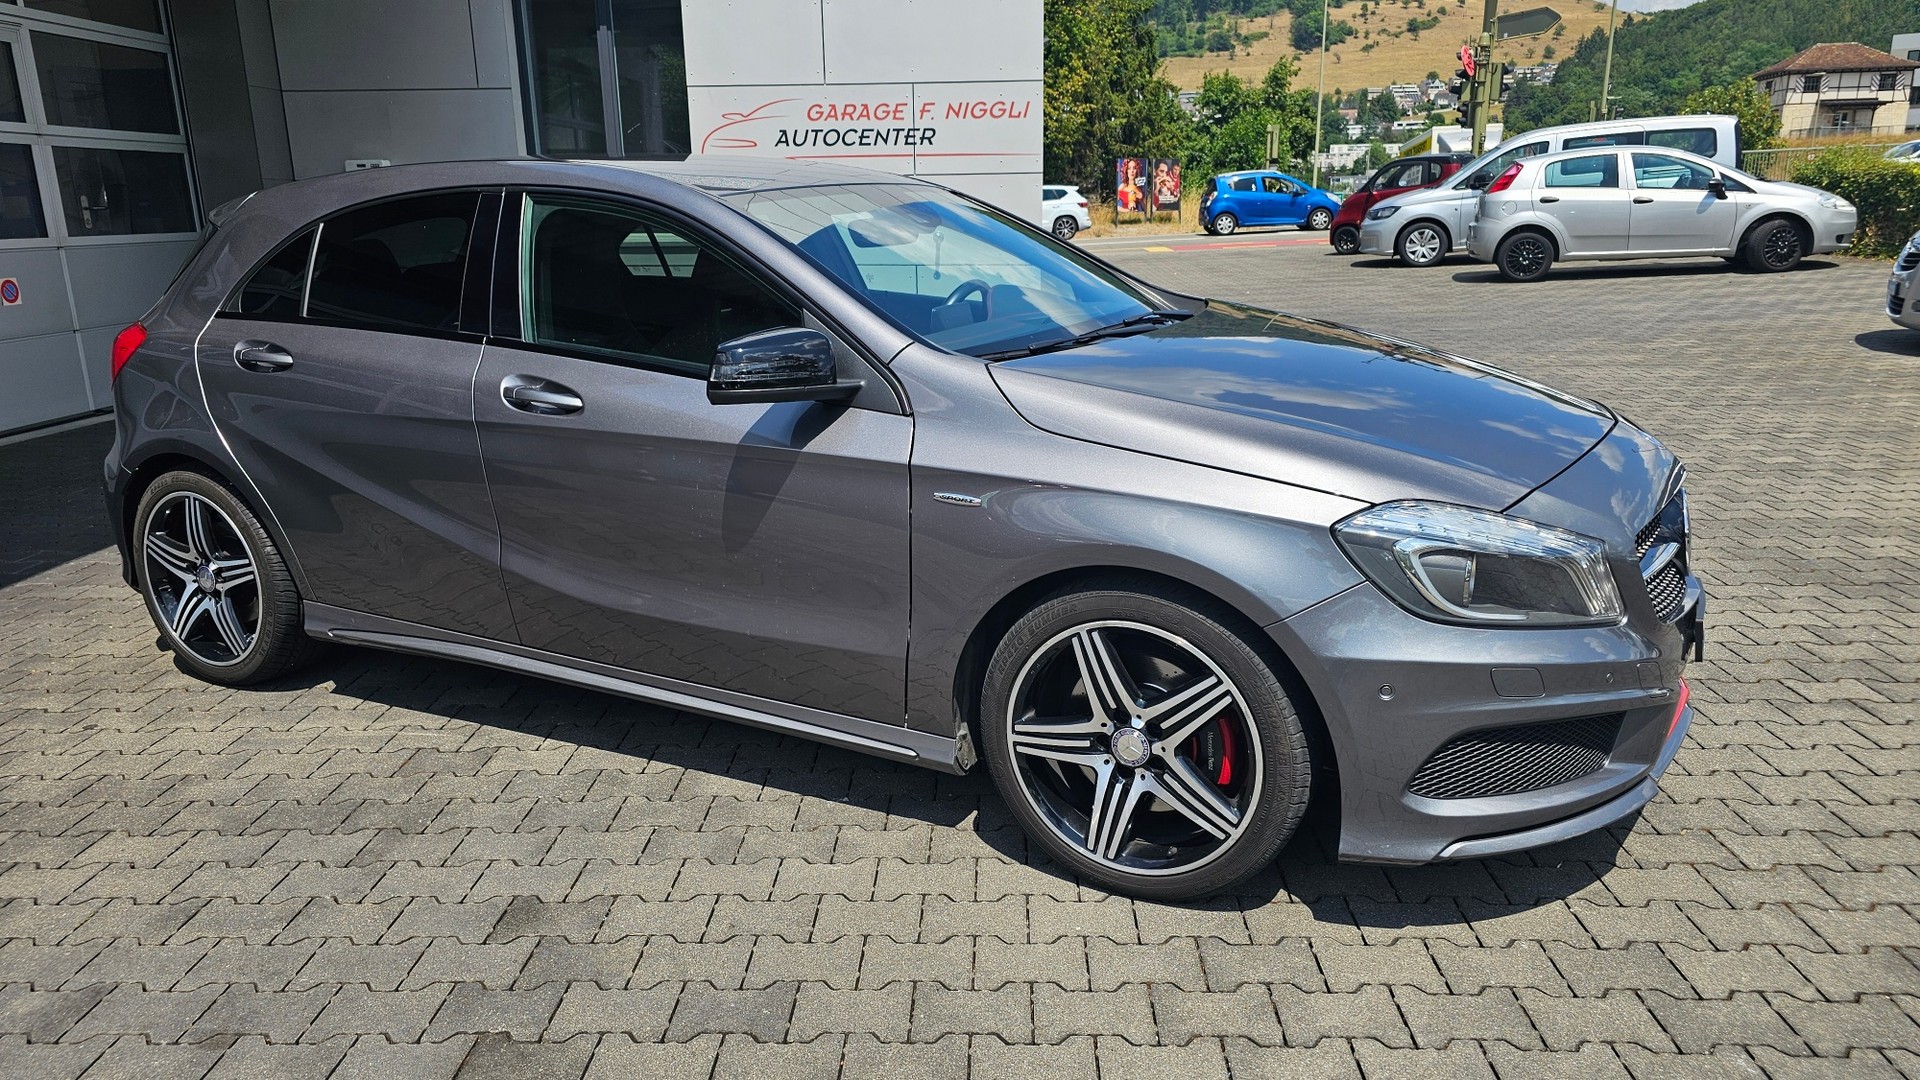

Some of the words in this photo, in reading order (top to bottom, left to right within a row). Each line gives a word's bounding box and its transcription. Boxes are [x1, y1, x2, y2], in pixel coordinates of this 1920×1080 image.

[806, 103, 908, 121] GARAGE
[919, 102, 936, 121] F.
[945, 101, 1030, 120] NIGGLI
[774, 128, 936, 147] AUTOCENTER
[940, 494, 975, 503] SPORT
